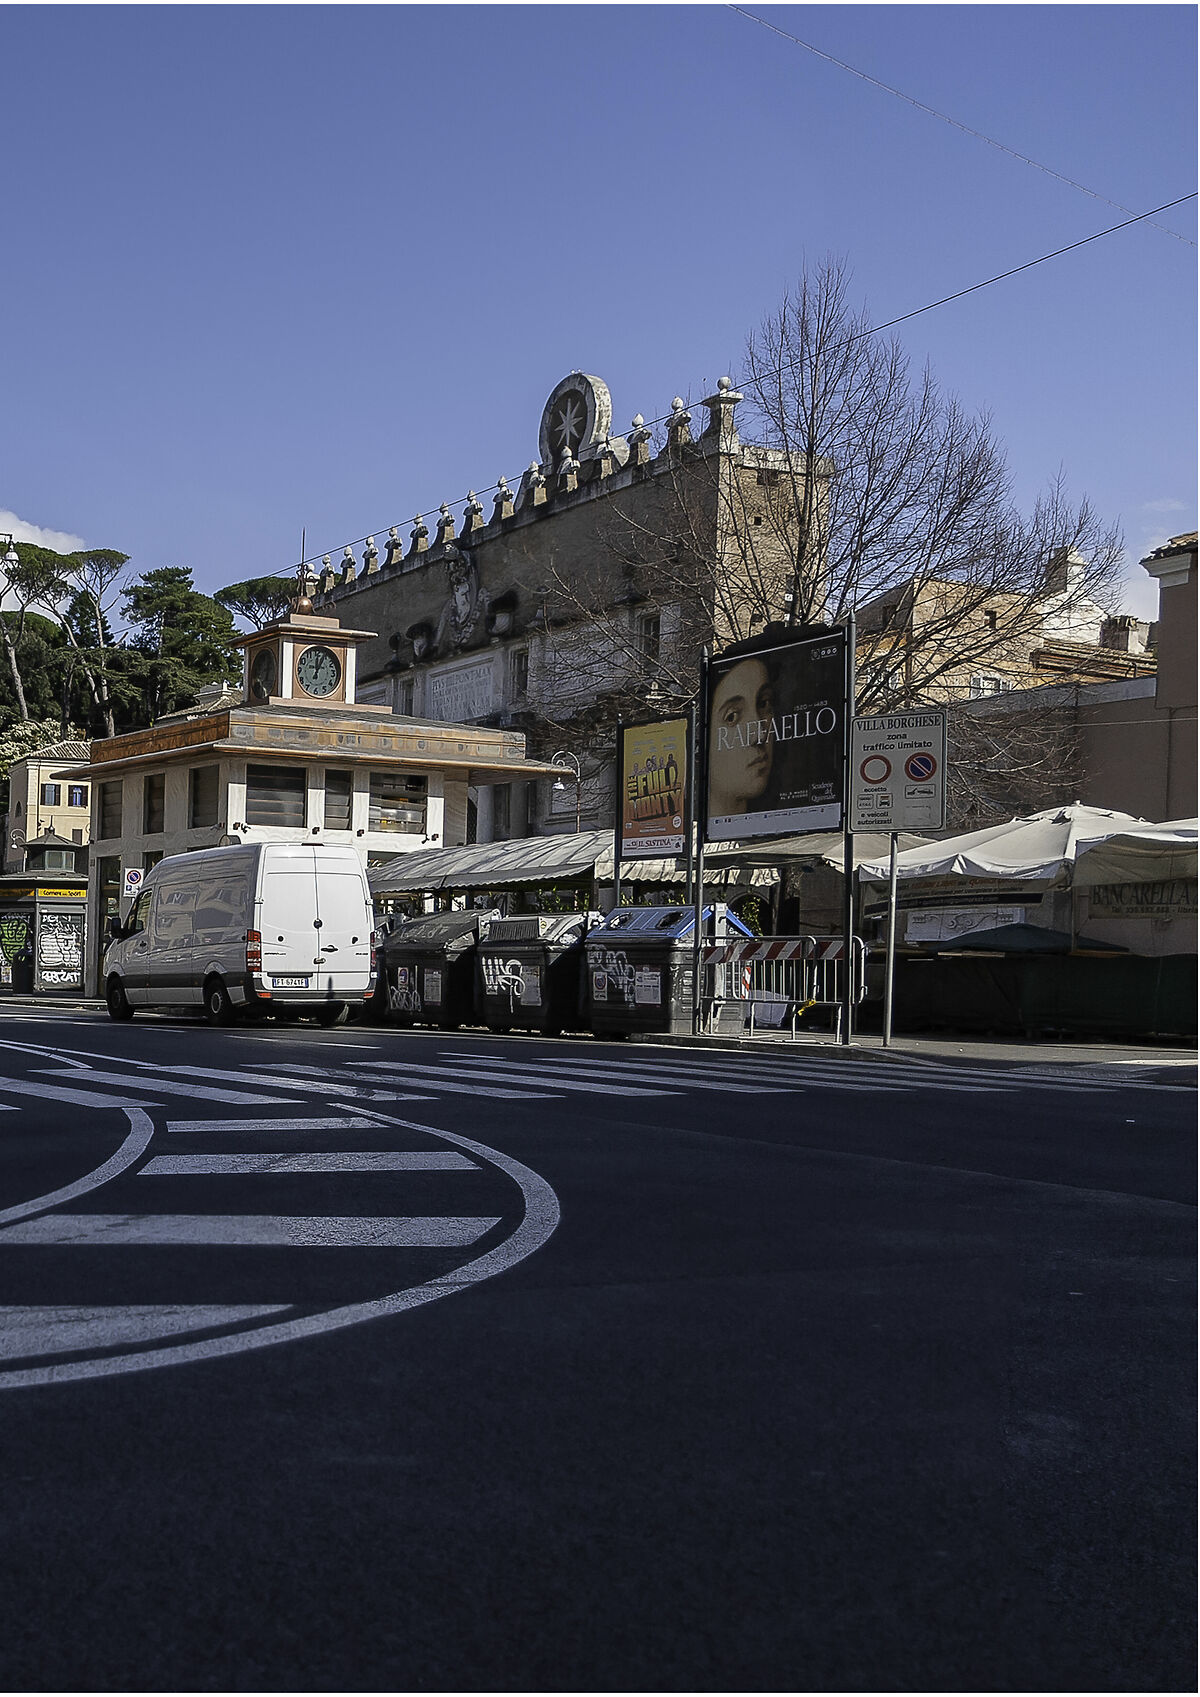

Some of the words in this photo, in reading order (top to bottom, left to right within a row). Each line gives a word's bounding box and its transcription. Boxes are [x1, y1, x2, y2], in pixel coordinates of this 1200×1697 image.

[717, 707, 836, 751] RAFFAELLO
[856, 719, 885, 731] VILLA
[887, 715, 941, 729] BORGHESE
[886, 733, 907, 741] zona
[863, 743, 895, 752] traffico
[897, 740, 933, 750] limitato
